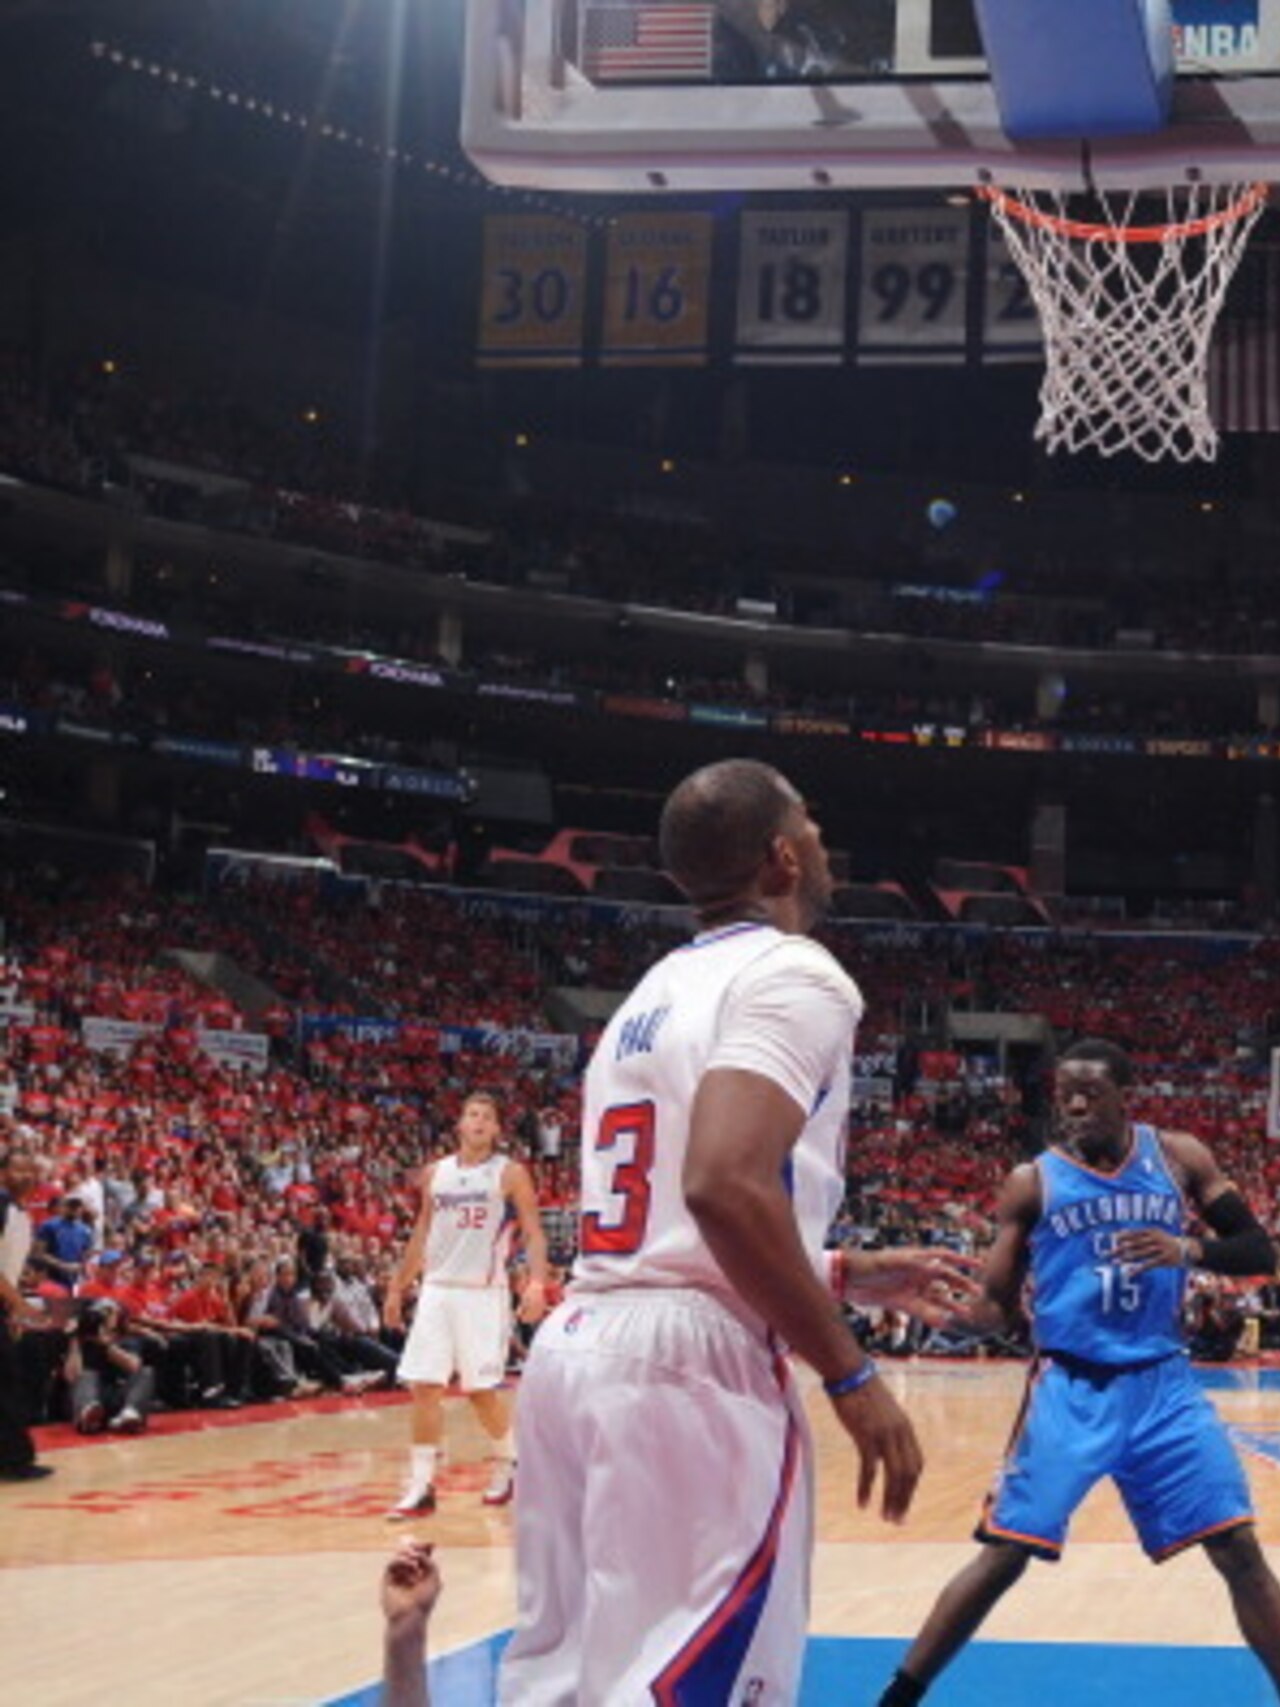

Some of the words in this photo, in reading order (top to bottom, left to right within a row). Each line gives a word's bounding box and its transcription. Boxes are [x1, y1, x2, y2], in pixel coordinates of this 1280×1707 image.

[494, 267, 566, 323] 30
[625, 265, 682, 323] 16
[758, 260, 821, 321] 18
[873, 262, 954, 322] 99
[582, 1098, 655, 1258] 3
[456, 1206, 488, 1229] 32
[1050, 1193, 1178, 1238] OKLAHOMA
[1093, 1263, 1140, 1314] 15
